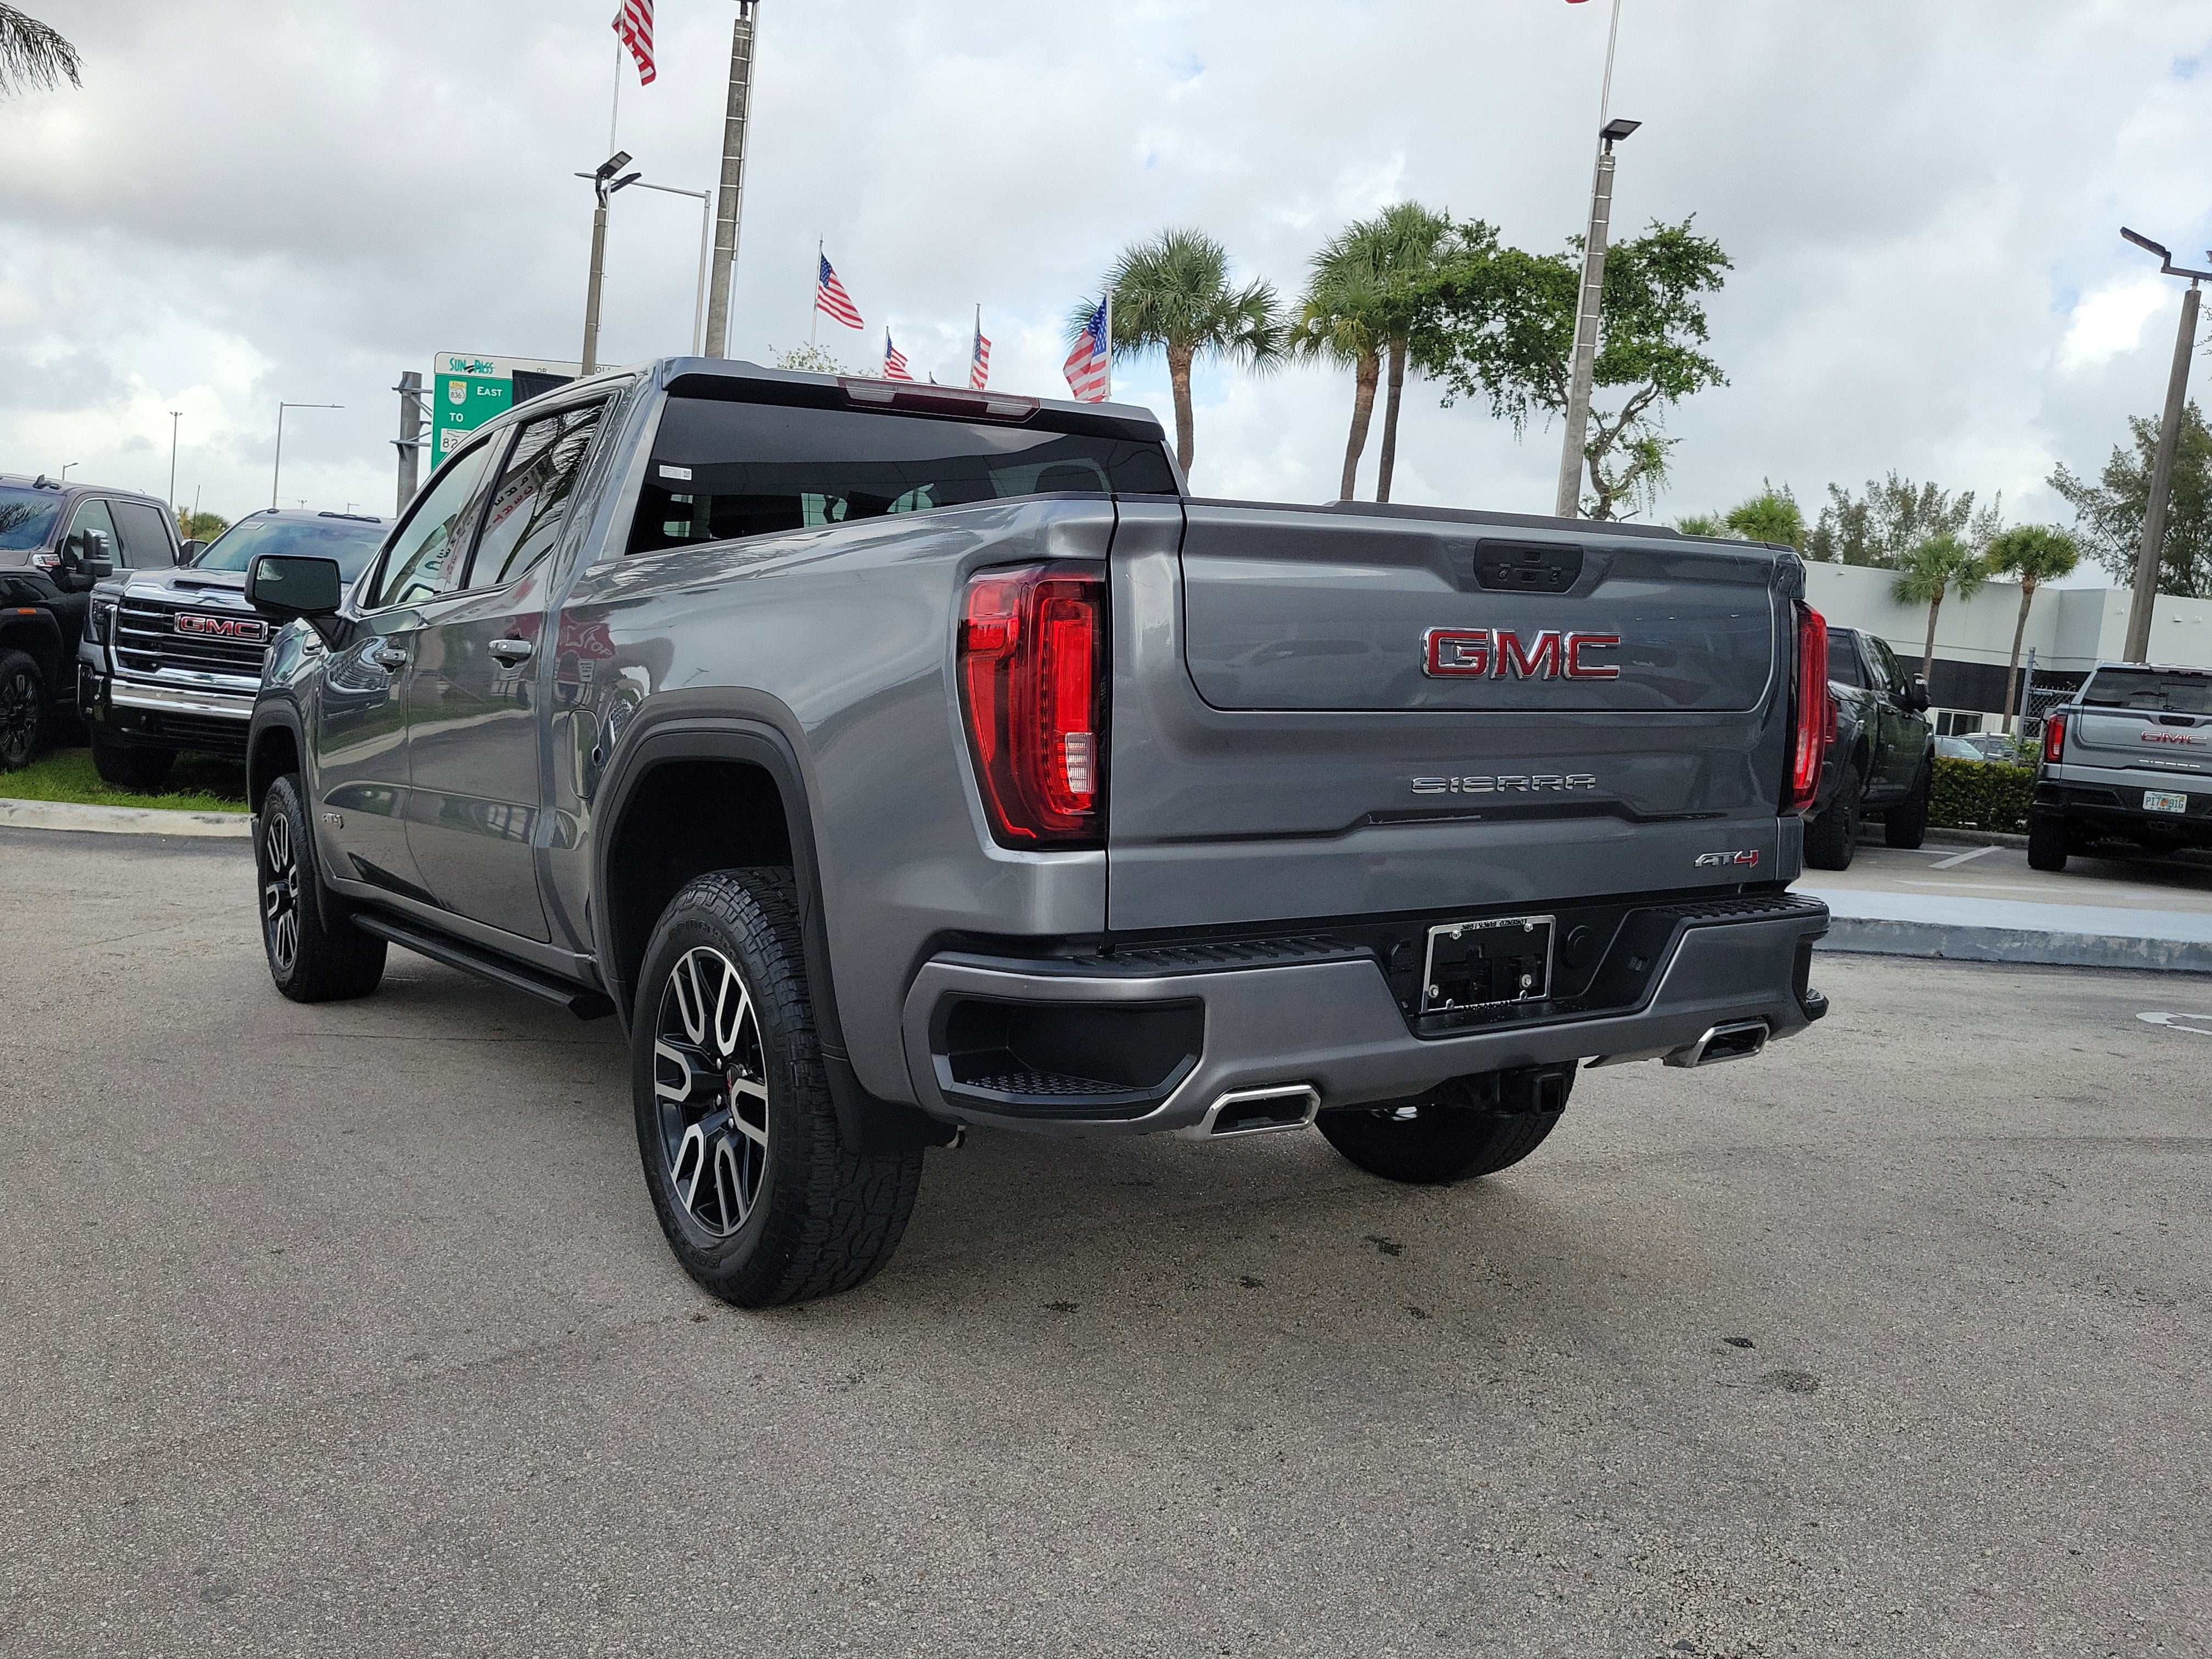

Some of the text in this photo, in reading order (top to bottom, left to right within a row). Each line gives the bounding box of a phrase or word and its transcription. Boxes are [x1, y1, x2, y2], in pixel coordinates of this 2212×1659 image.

[477, 386, 503, 397] EAST
[449, 412, 464, 422] TO
[180, 616, 260, 638] GMC
[1421, 627, 1621, 680] GMC
[2141, 731, 2207, 746] GMC
[1411, 774, 1596, 794] SIERRA
[1694, 849, 1758, 868] AT4
